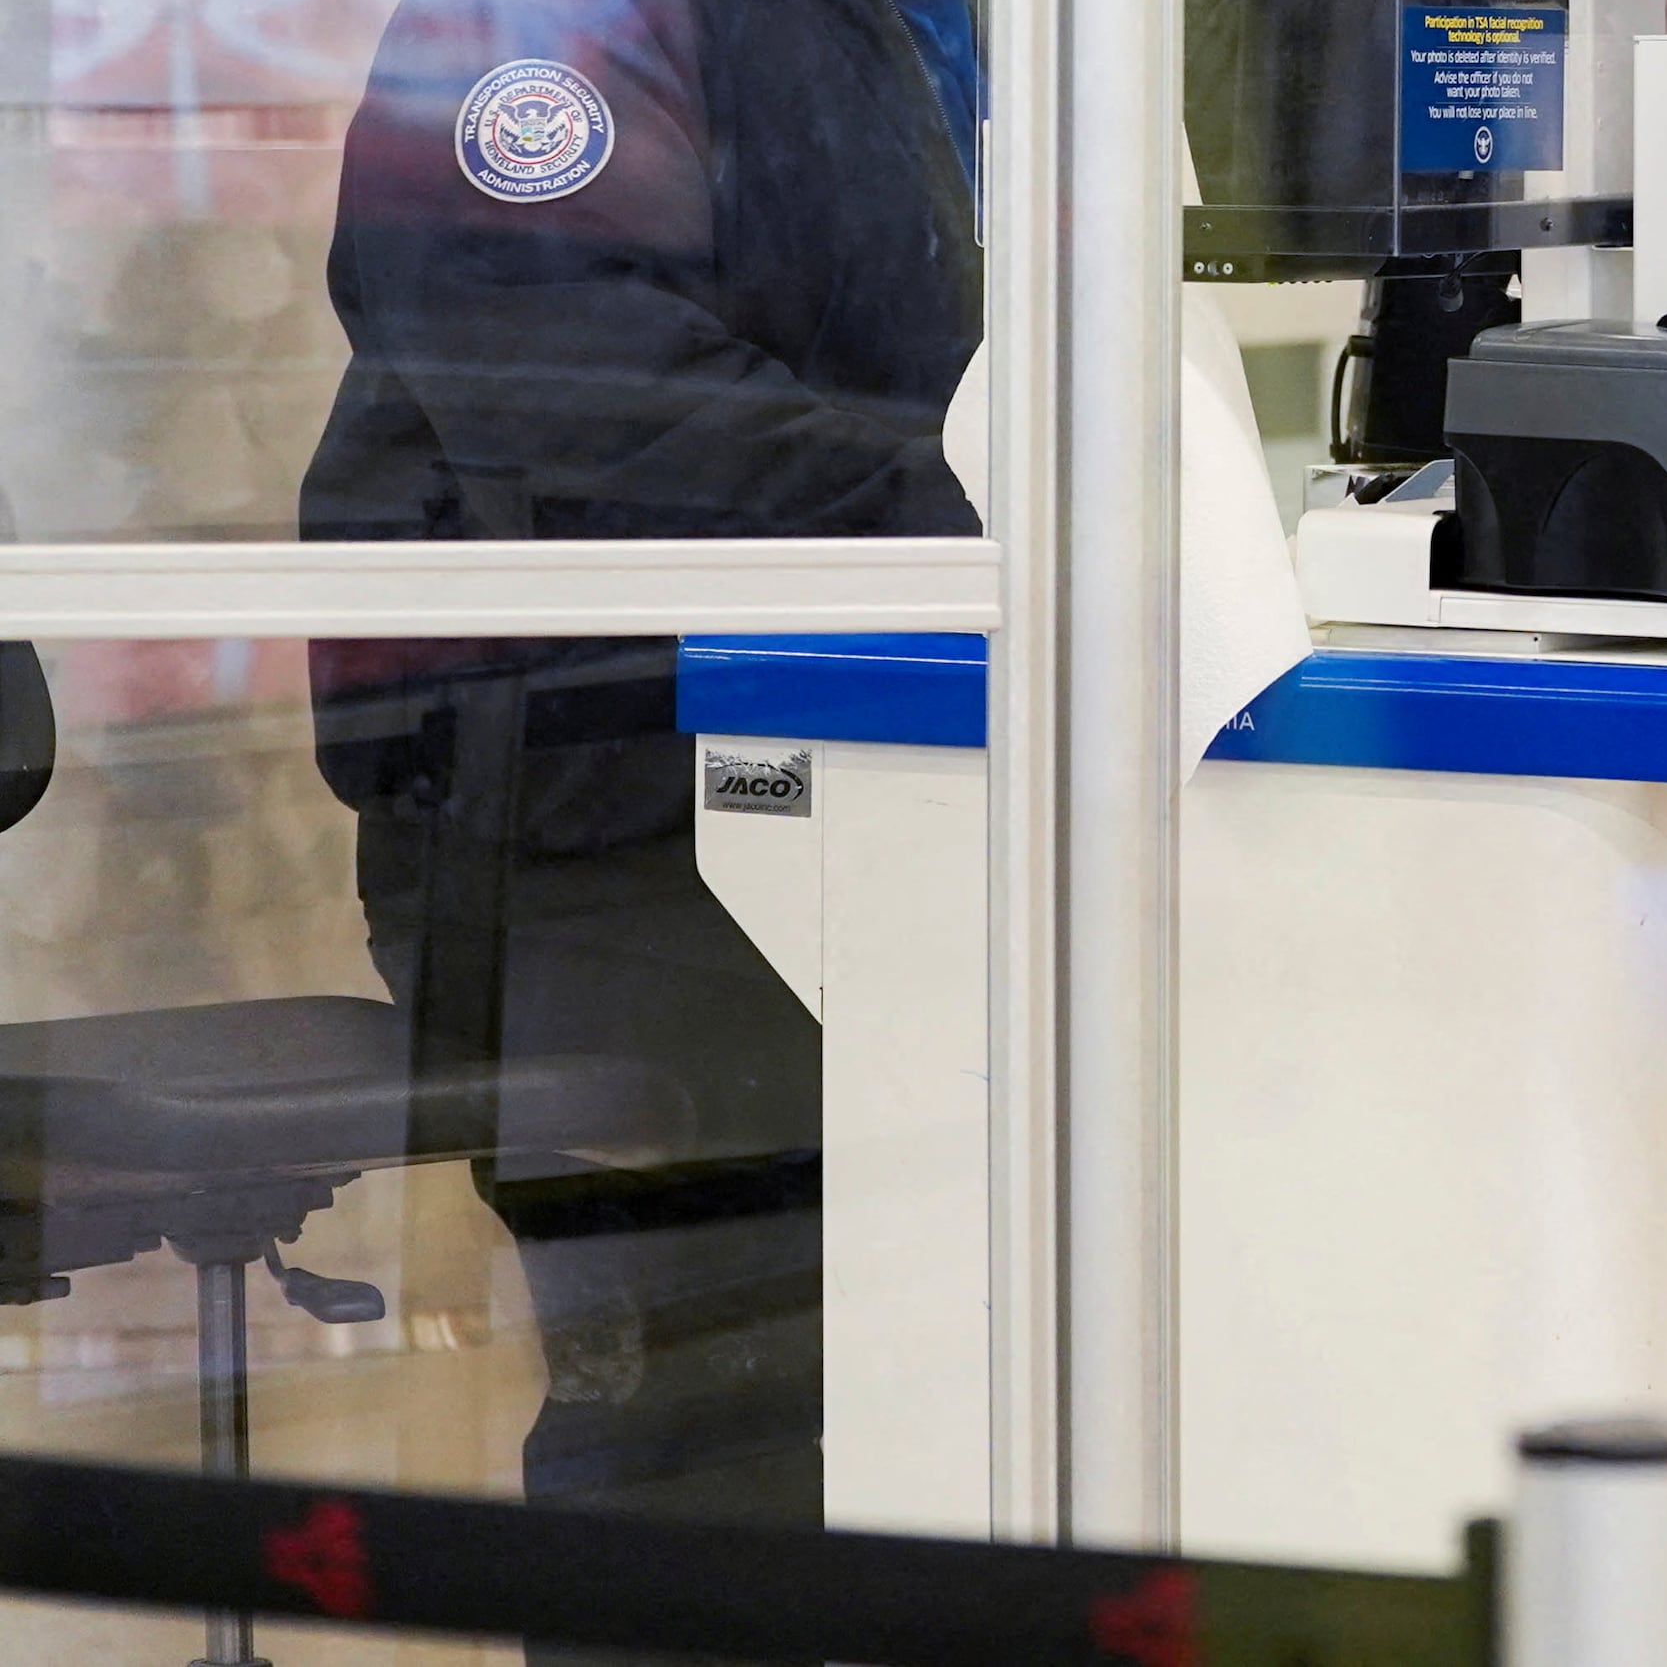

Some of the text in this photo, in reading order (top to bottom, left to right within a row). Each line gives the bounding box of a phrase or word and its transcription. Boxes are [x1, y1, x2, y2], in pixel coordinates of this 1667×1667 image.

[1425, 15, 1543, 31] Participation in TSA facial recognition
[1448, 30, 1520, 44] technology is optional.
[1411, 50, 1426, 62] Your
[1427, 50, 1447, 64] photo
[1448, 51, 1454, 63] is
[1455, 51, 1479, 63] deleted
[1480, 52, 1496, 63] after
[1497, 52, 1522, 65] identity
[1523, 53, 1529, 64] is
[1434, 71, 1533, 86] Advise the officer if you do not
[1446, 87, 1464, 97] want
[1464, 89, 1481, 99] your
[1481, 87, 1500, 98] photo
[465, 67, 604, 143] TRANSPORTATION SECURITY
[501, 85, 572, 111] DEPARTMENT
[571, 109, 583, 123] OF
[1428, 106, 1442, 118] You
[1443, 106, 1455, 118] will
[1456, 107, 1467, 118] not
[1468, 107, 1481, 118] lose
[1482, 109, 1497, 120] your
[1499, 107, 1516, 120] place
[1517, 107, 1524, 118] in
[484, 134, 583, 175] HOMELAND SECURITY
[478, 160, 591, 193] ADMINISTRATION
[716, 777, 791, 797] JACO
